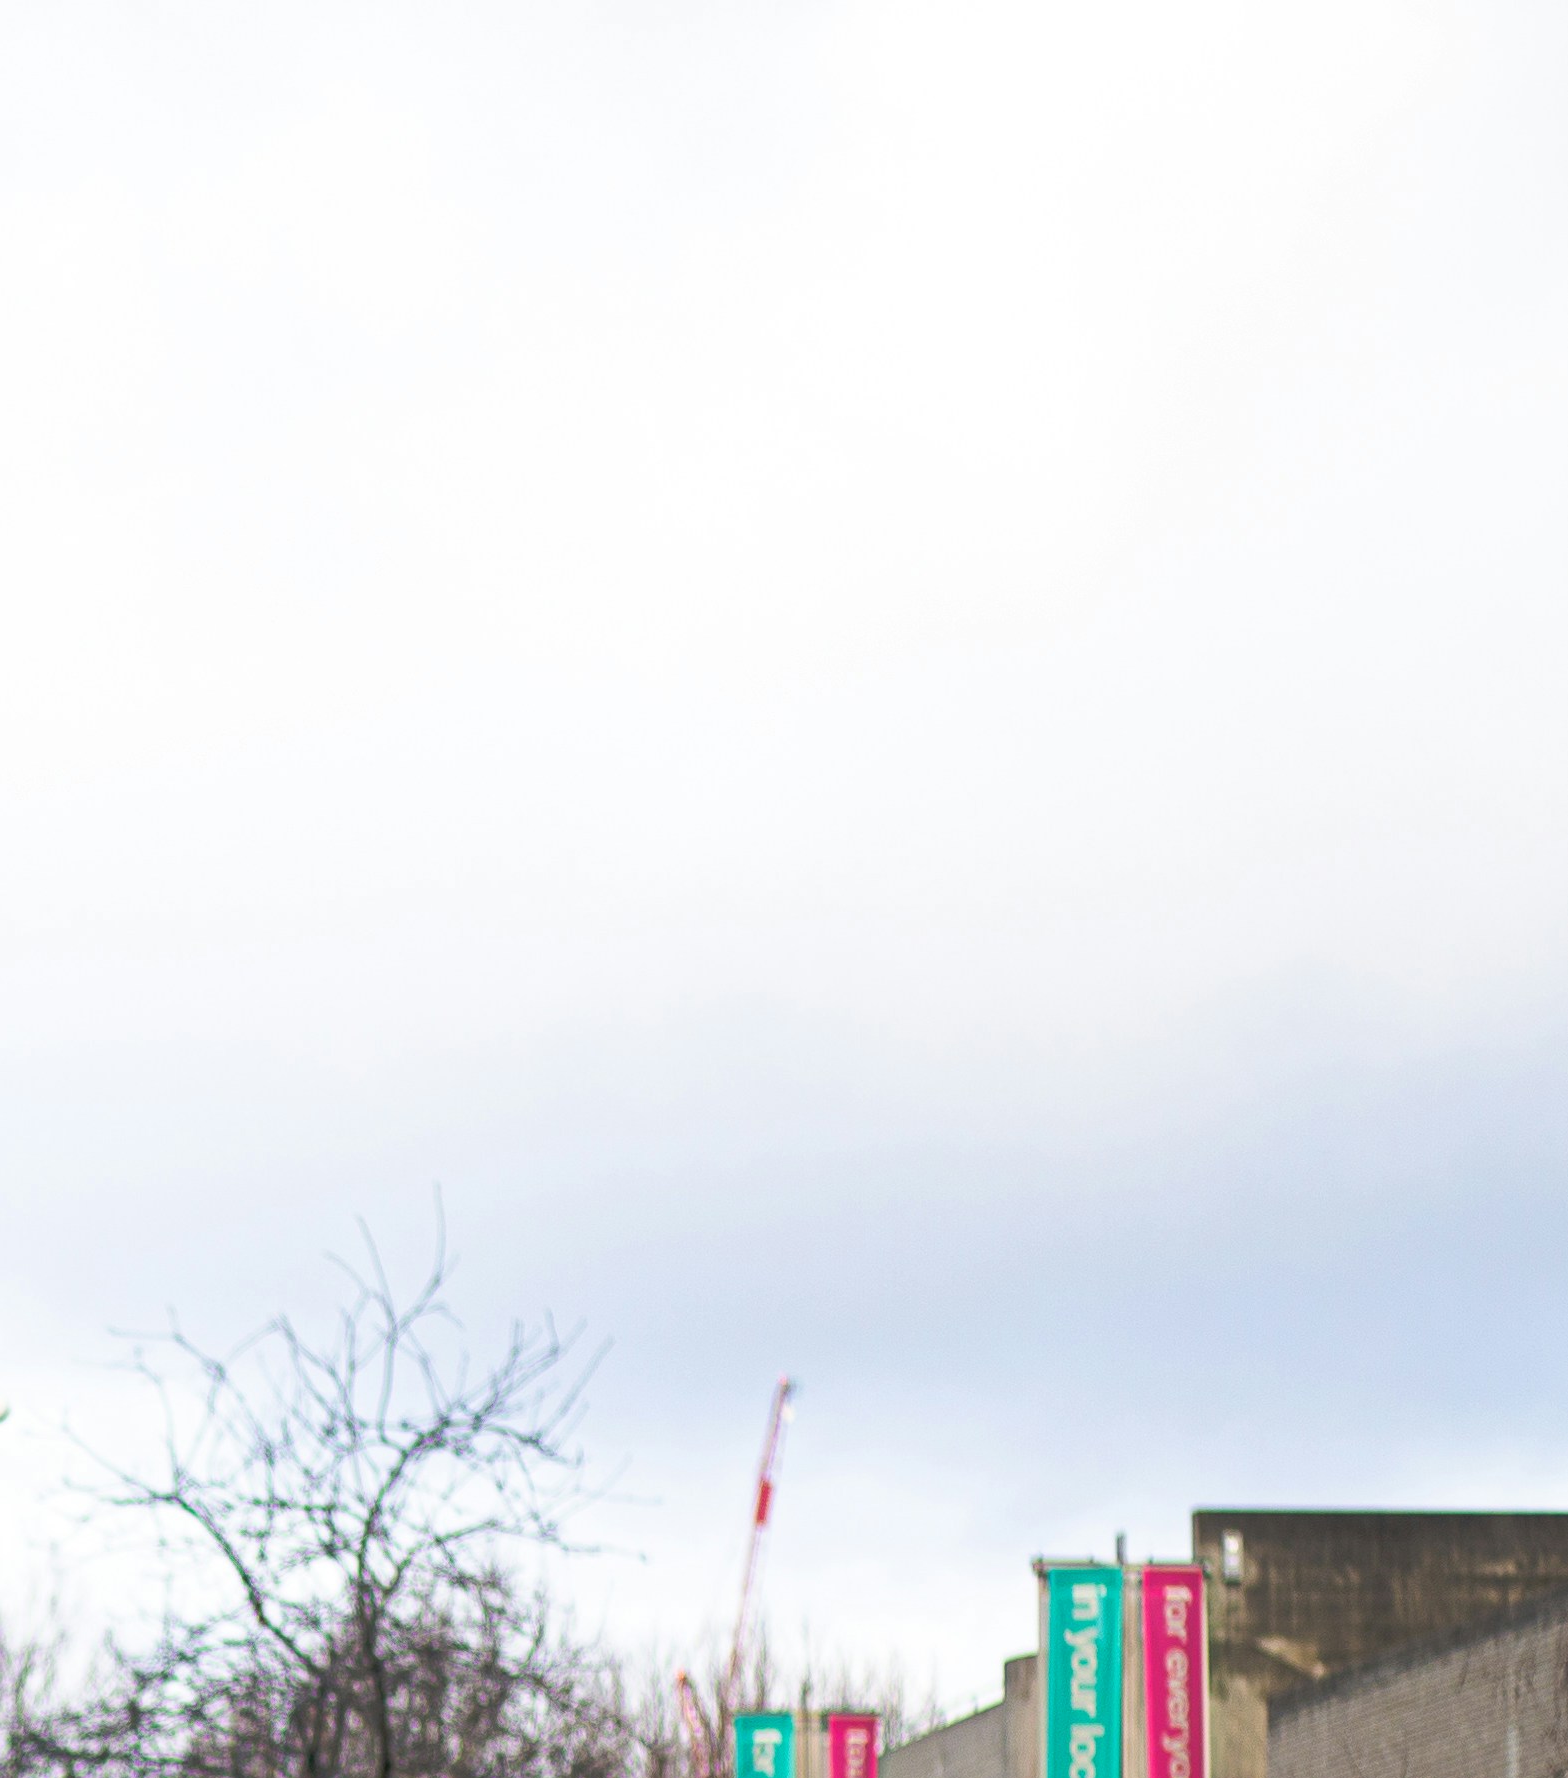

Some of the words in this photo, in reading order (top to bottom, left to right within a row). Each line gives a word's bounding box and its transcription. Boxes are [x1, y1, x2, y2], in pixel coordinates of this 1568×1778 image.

[1071, 1583, 1107, 1620] in
[1164, 1585, 1193, 1641] for
[1065, 1626, 1098, 1718] your
